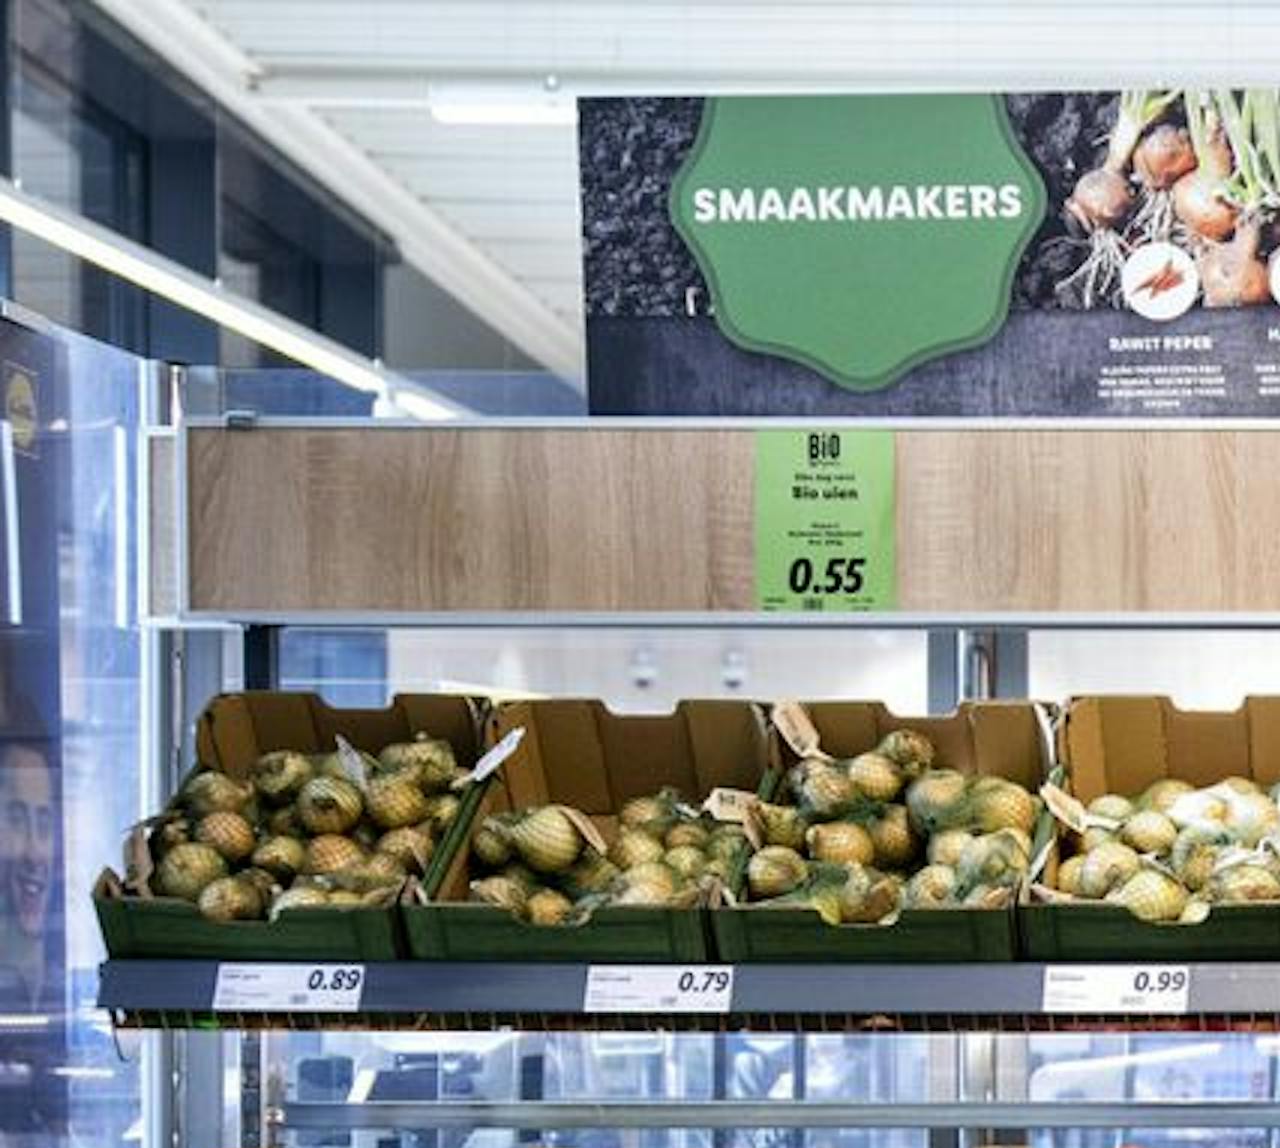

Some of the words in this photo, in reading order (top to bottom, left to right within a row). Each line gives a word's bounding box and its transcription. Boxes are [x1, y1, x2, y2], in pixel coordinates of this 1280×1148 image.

[693, 184, 1022, 223] SMAAKMAKERS
[1163, 335, 1213, 351] PEPER
[789, 558, 866, 594] 0.55
[307, 969, 361, 991] 0.89
[677, 971, 730, 993] 0.79
[1133, 971, 1187, 993] 0.99
